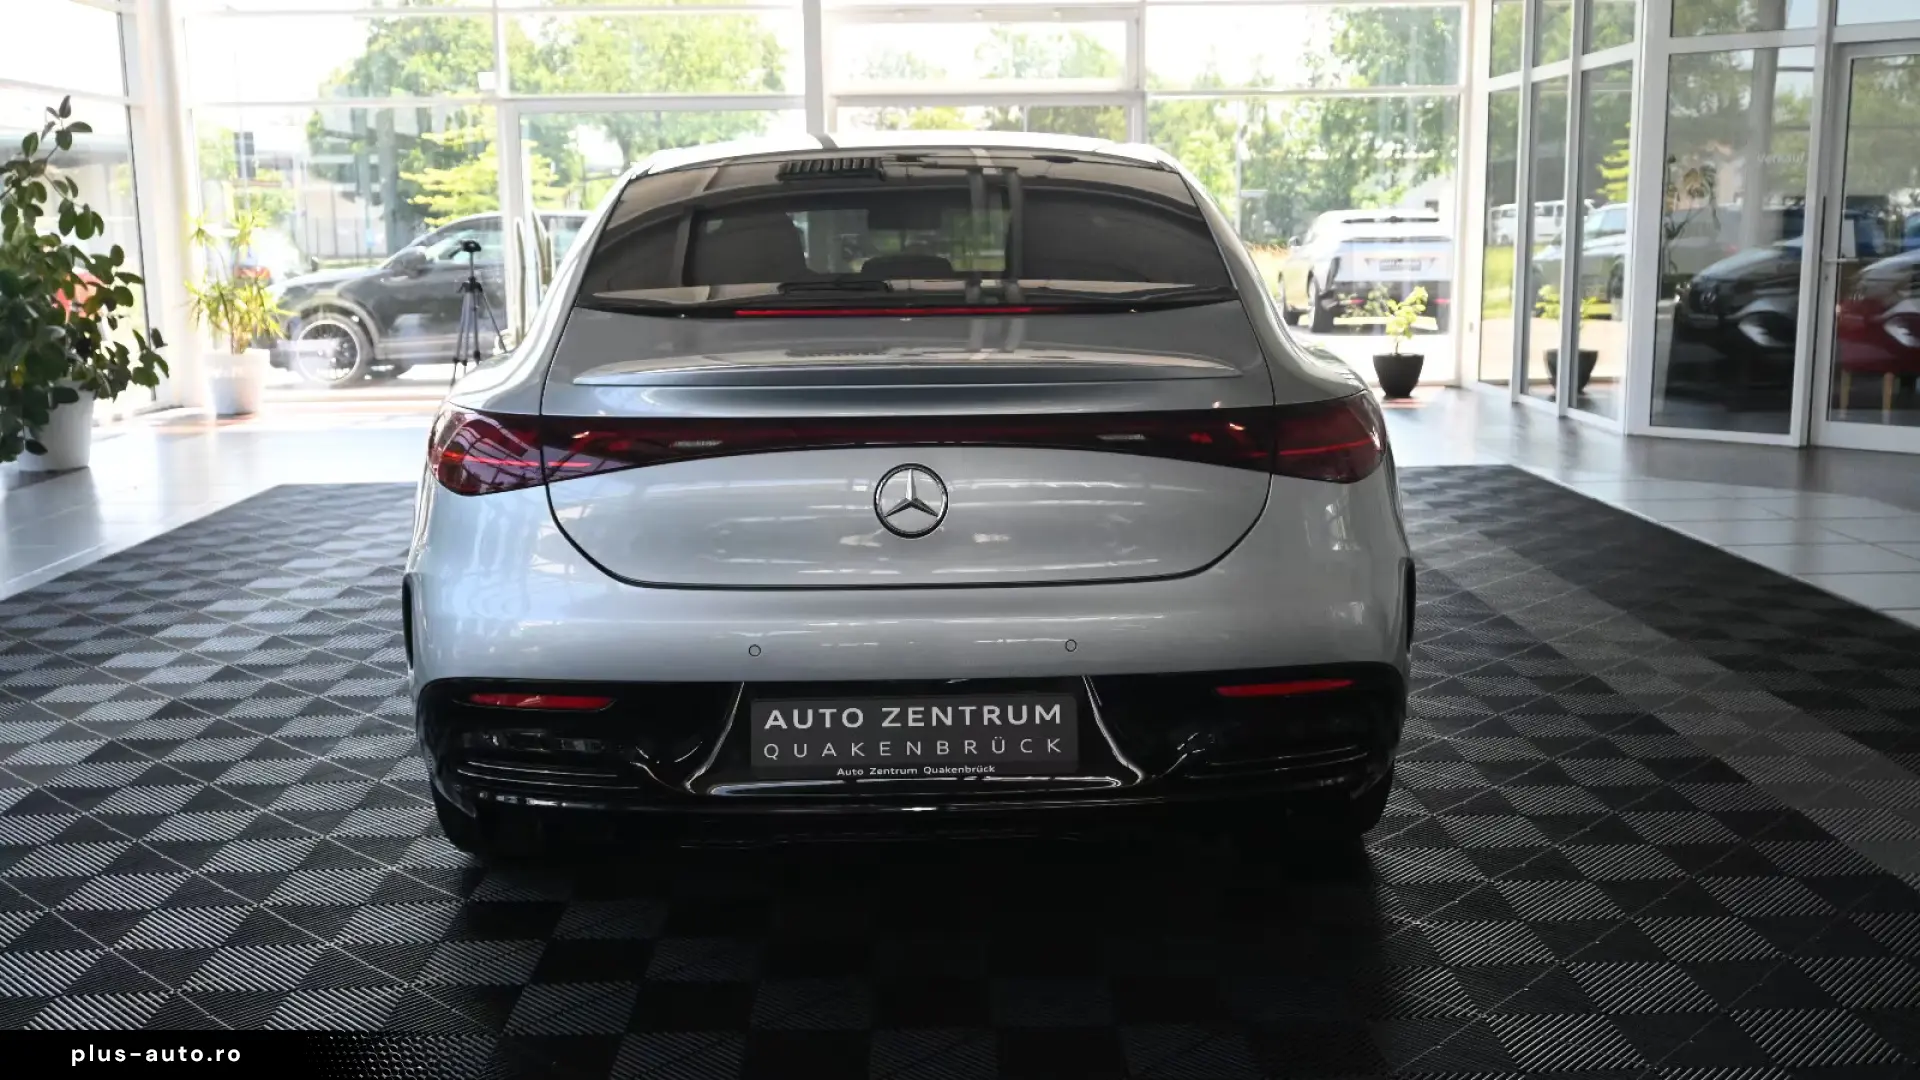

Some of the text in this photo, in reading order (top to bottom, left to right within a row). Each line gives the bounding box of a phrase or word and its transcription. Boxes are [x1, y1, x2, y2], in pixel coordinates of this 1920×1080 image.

[764, 703, 1061, 730] AUTO ZENTRUM
[763, 736, 1062, 760] QUAKENBRÜCK
[836, 765, 996, 776] Auto Zentrum Quakenbrück
